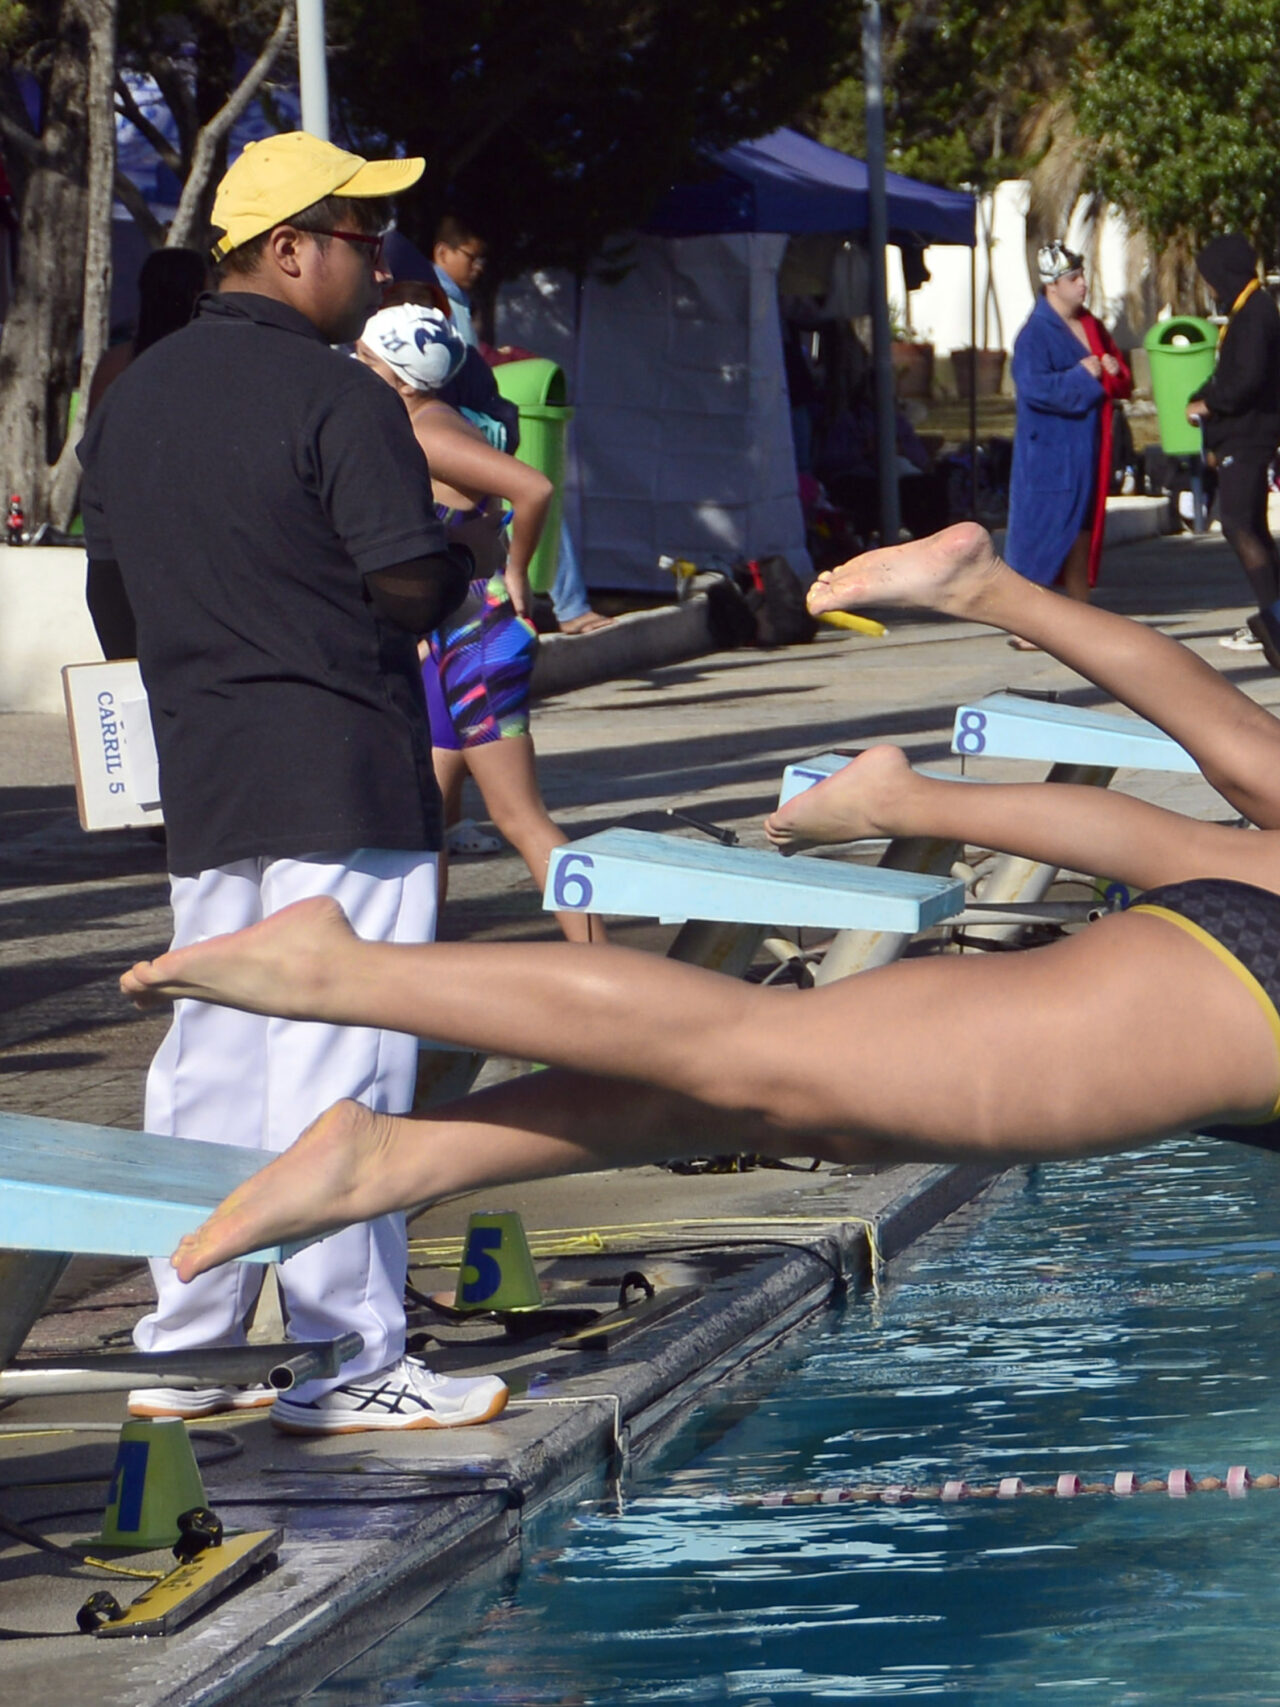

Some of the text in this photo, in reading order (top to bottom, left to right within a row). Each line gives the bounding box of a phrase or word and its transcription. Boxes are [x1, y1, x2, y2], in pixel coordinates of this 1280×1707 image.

[98, 691, 125, 795] CARRIL 5
[957, 711, 987, 754] 8
[554, 853, 595, 908] 6
[462, 1227, 502, 1304] 5
